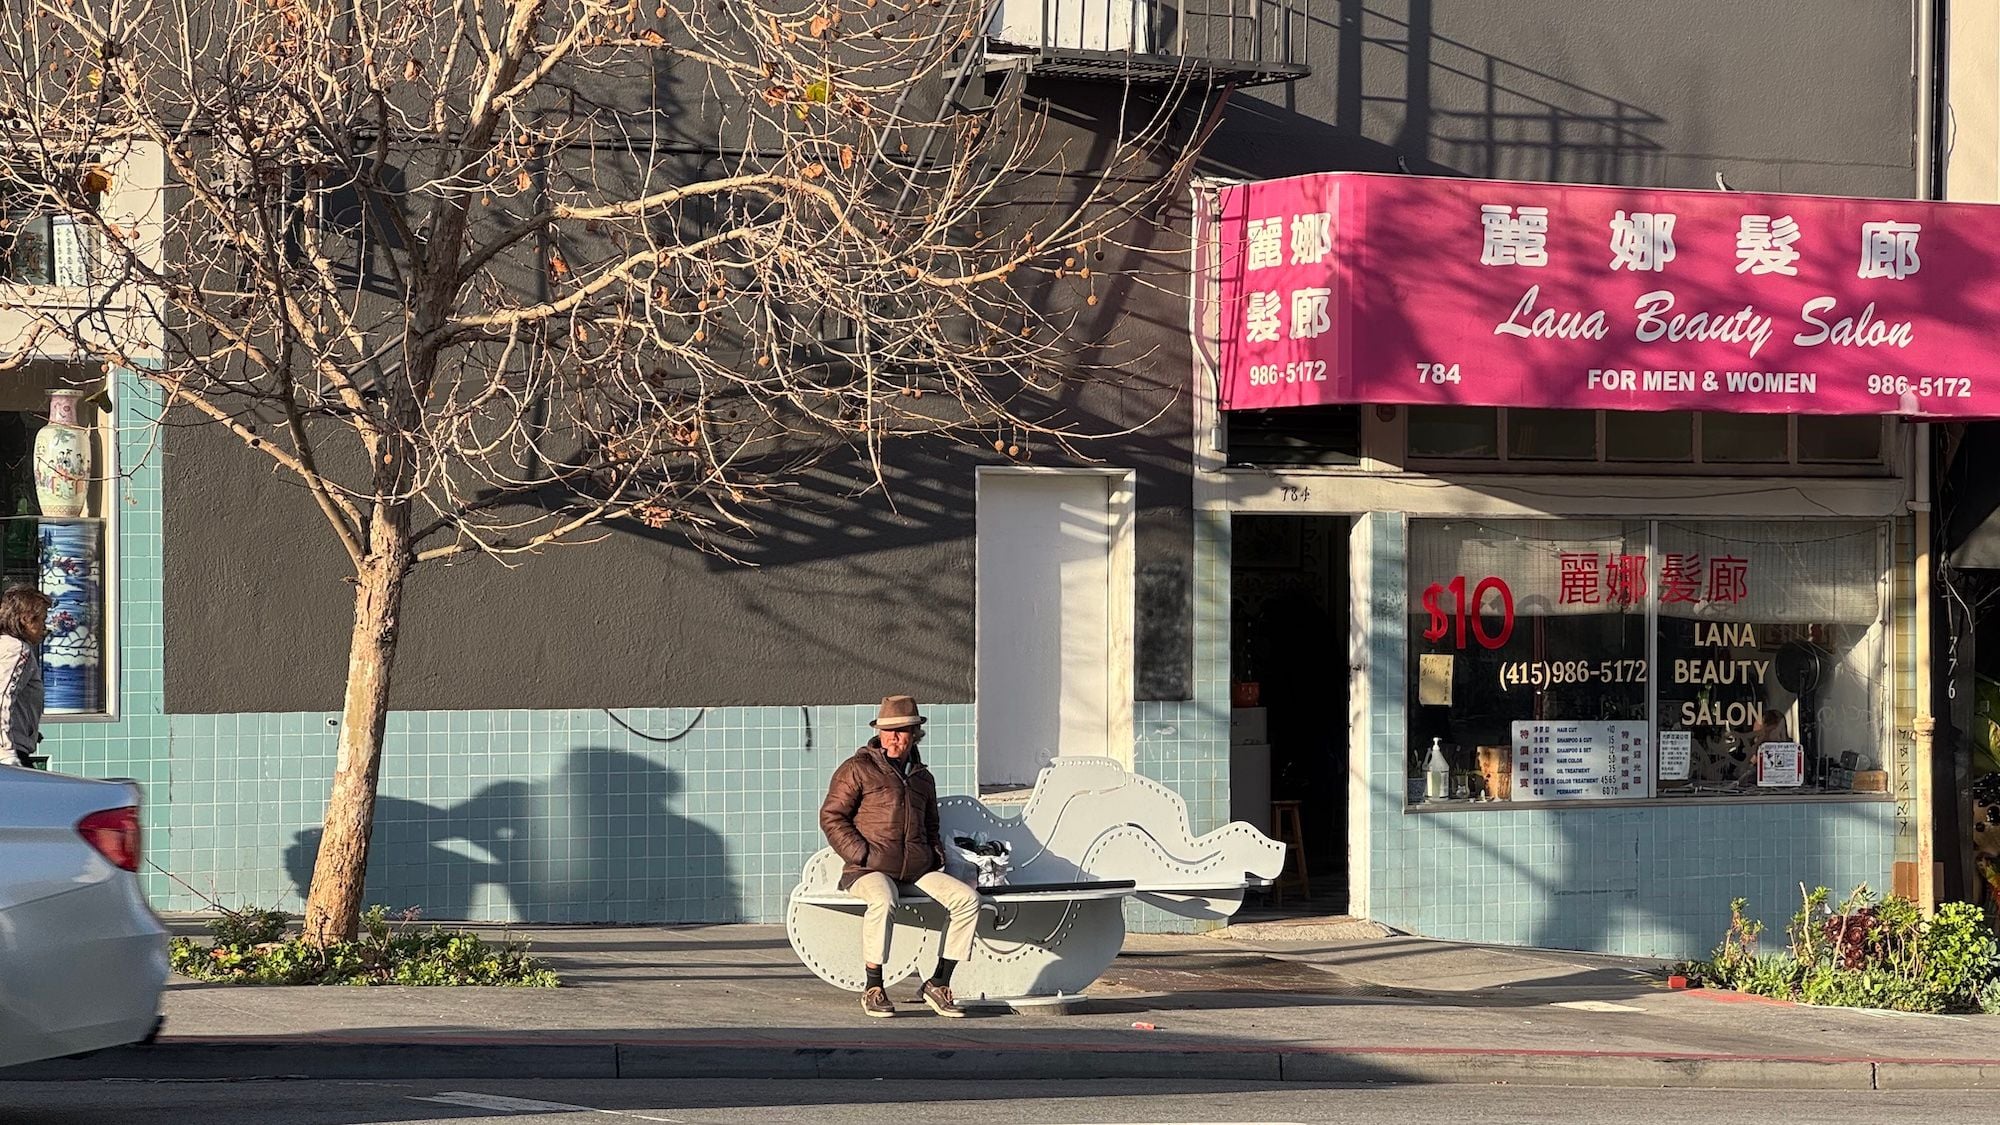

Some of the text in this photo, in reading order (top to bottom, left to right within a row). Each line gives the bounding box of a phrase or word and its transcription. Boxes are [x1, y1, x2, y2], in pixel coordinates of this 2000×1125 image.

[1247, 212, 1332, 271] 麗娜
[1479, 204, 1922, 282] 麗娜髮廊
[1246, 287, 1332, 343] 髮廊
[1634, 290, 1773, 359] Beauty
[1793, 296, 1914, 348] Salon
[1249, 360, 1327, 387] 986-5172
[1416, 362, 1461, 385] 784
[1587, 369, 1817, 393] FOR MEN & WOMEN
[1867, 374, 1971, 397] 986-5172
[1280, 486, 1311, 503] 784
[1422, 575, 1514, 650] $10
[1694, 622, 1757, 648] LANA
[1499, 660, 1648, 692] (415)986-5172
[1674, 659, 1770, 685] BEAUTY
[1681, 701, 1764, 727] SALON
